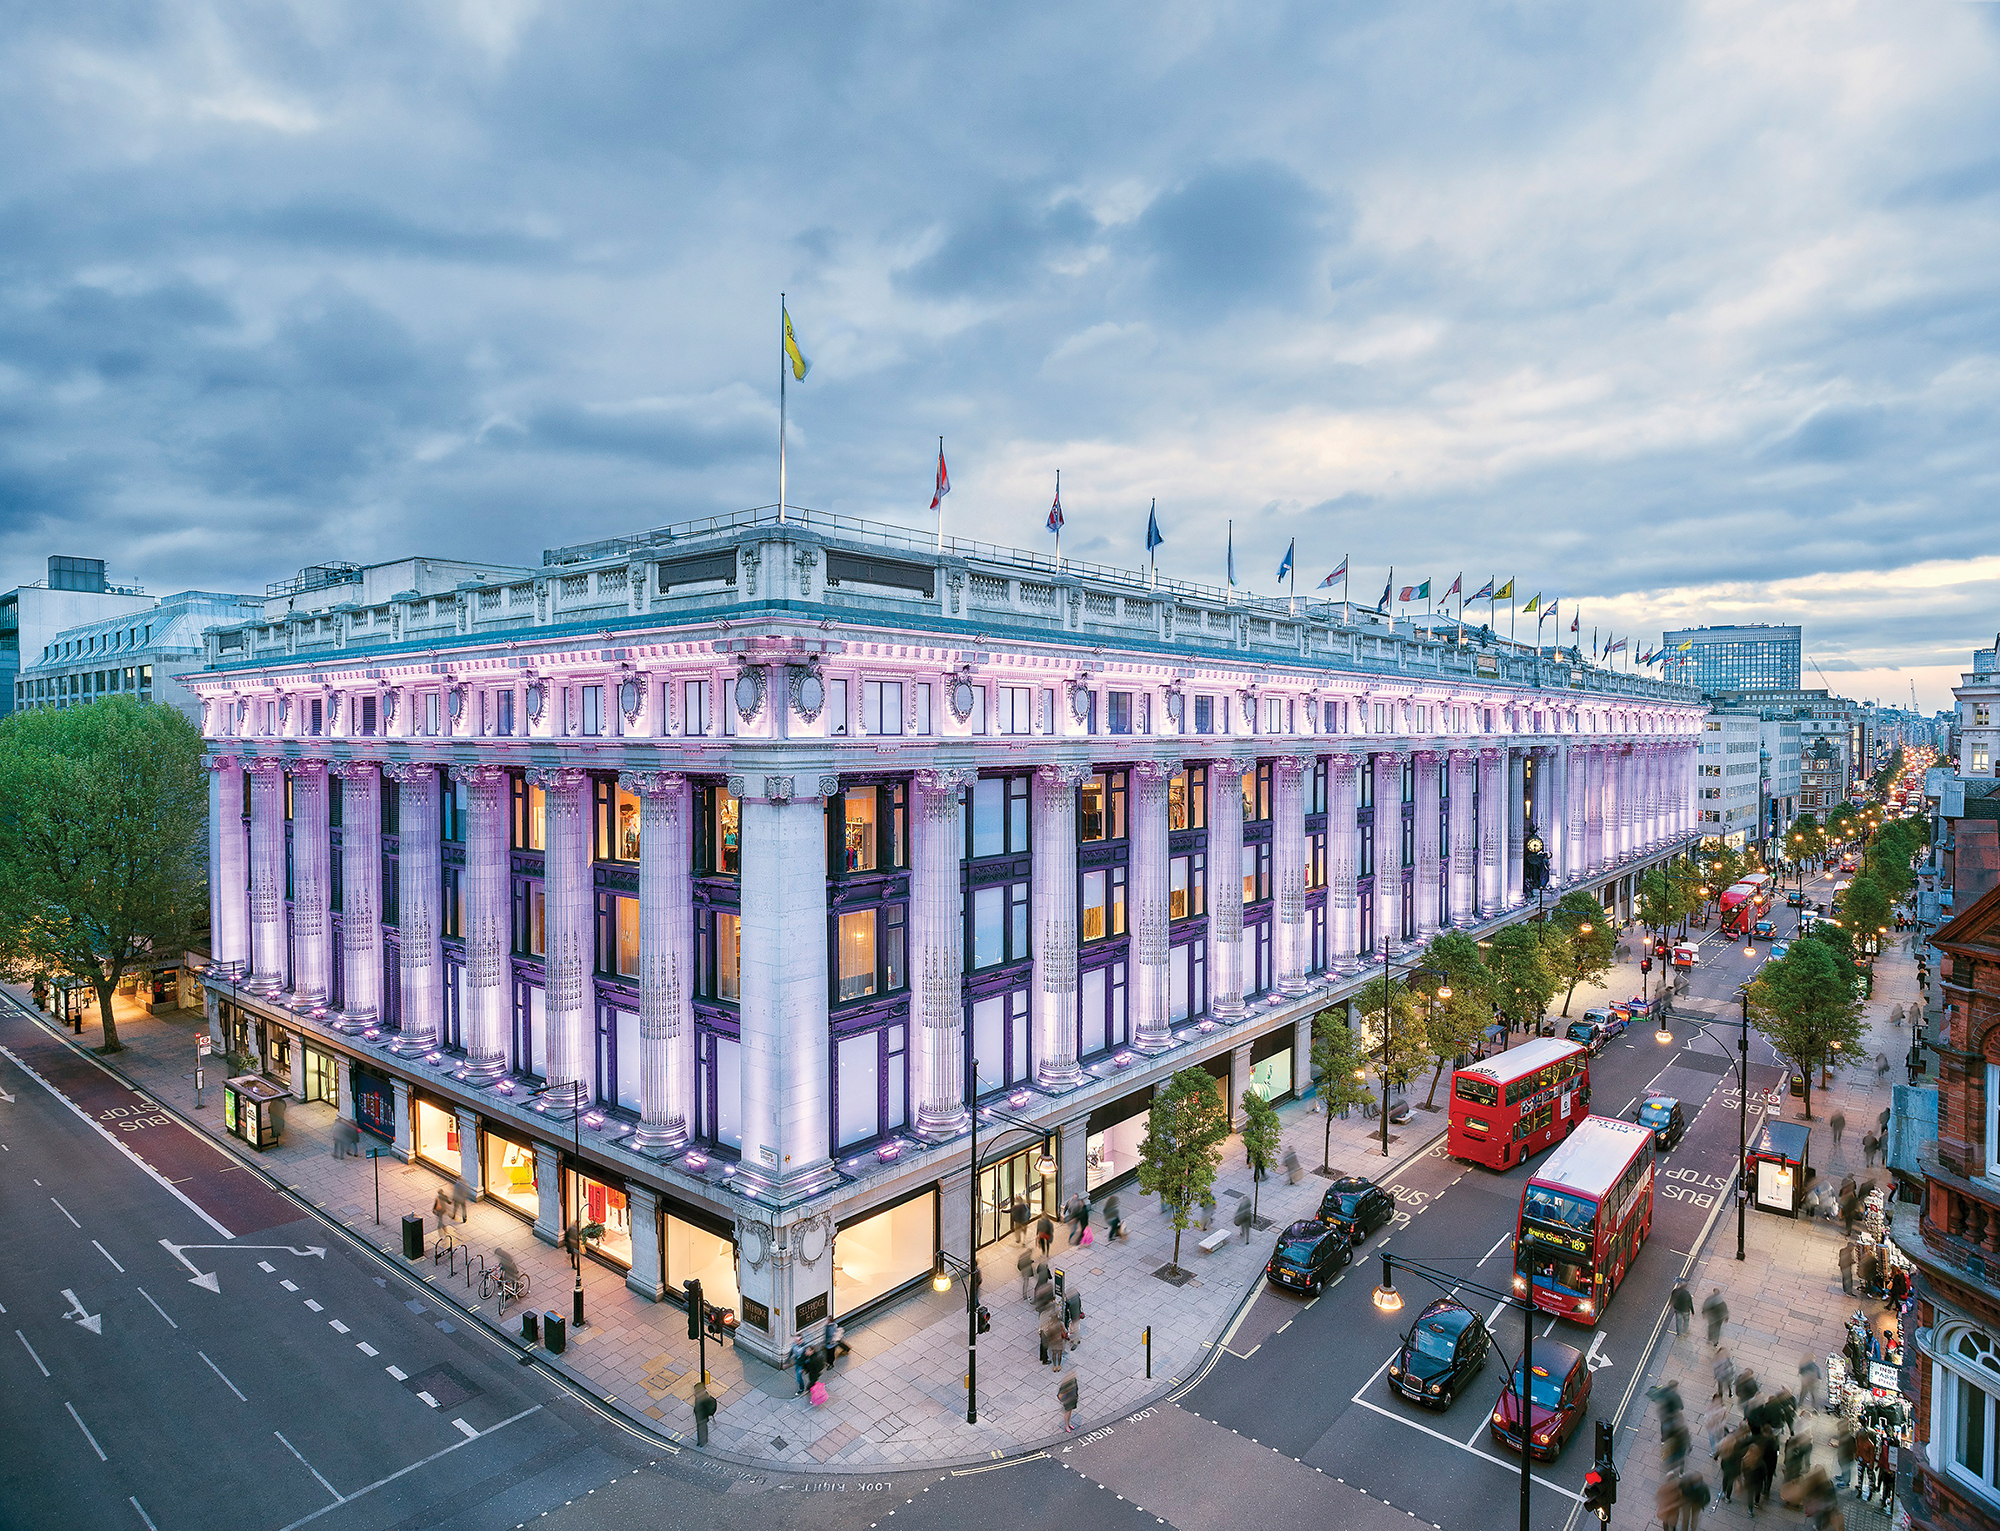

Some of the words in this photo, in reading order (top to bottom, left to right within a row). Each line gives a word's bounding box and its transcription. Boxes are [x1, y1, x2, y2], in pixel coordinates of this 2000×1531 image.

[99, 1102, 160, 1120] STOP
[1721, 1098, 1763, 1115] BUS
[118, 1114, 171, 1132] BUS
[1665, 1167, 1727, 1190] STOP
[1387, 1184, 1430, 1206] BUS
[1661, 1184, 1715, 1209] BUS
[1528, 1227, 1545, 1239] Brent
[1545, 1232, 1563, 1244] Cross
[1571, 1239, 1586, 1252] 189
[1541, 1290, 1563, 1301] Metroline
[744, 1300, 767, 1319] SELFRIDGE
[798, 1296, 825, 1316] SELFRIDGE
[1125, 1406, 1159, 1425] LOOK
[1077, 1426, 1115, 1447] RIGHT
[800, 1482, 846, 1493] RIGHT
[858, 1481, 893, 1492] LOOK
